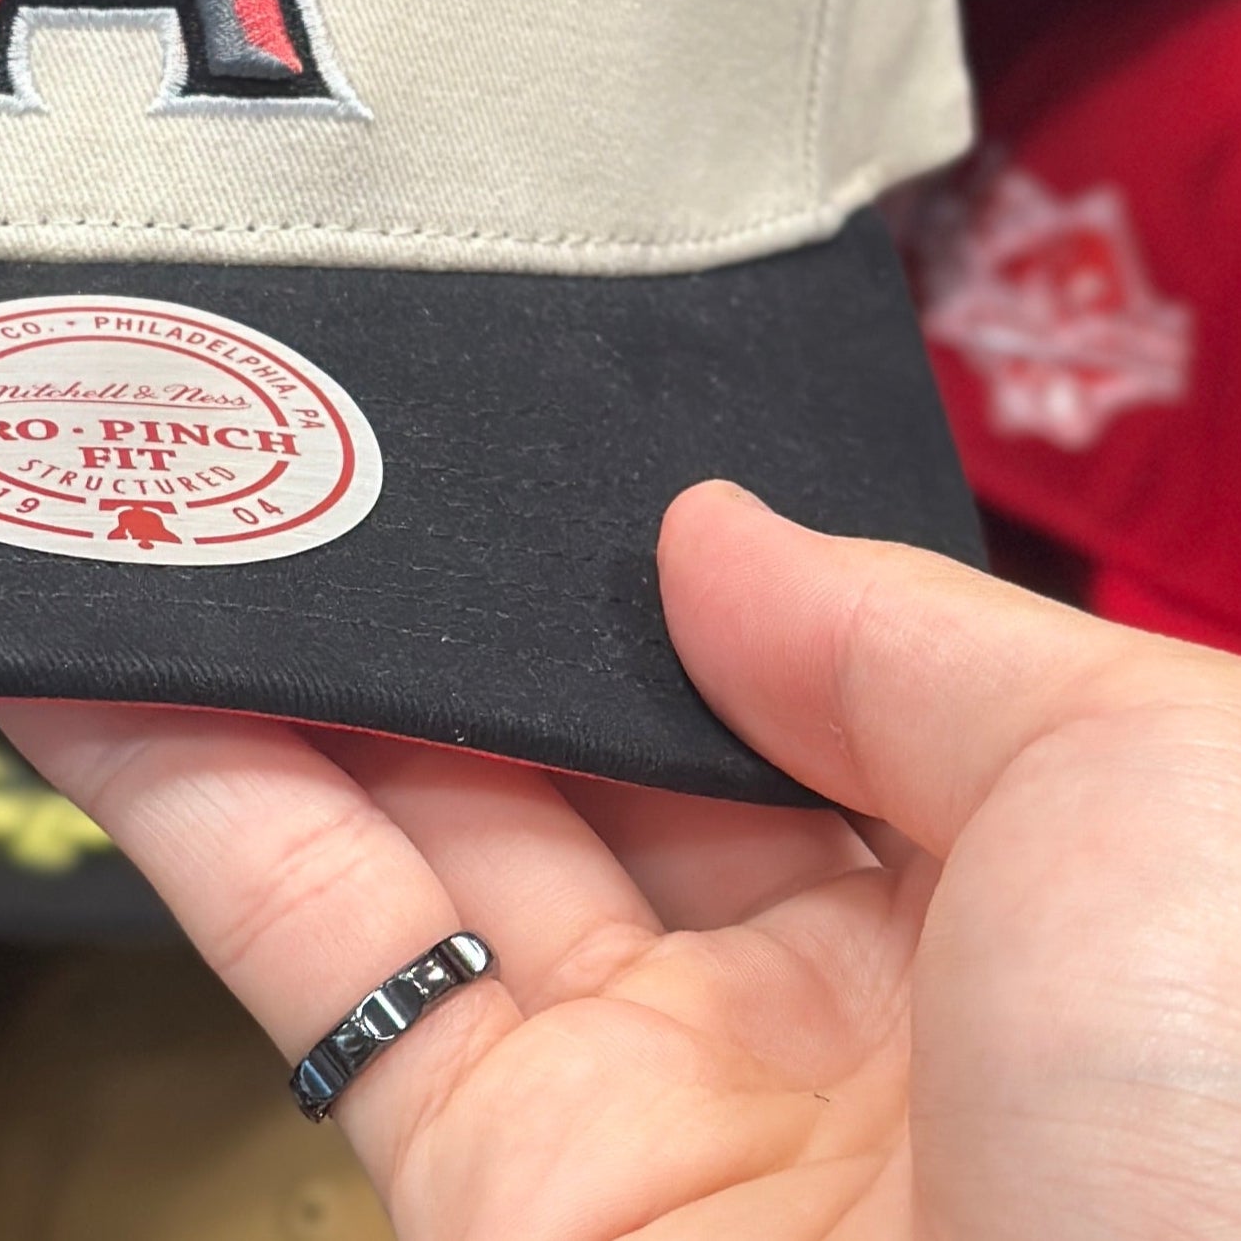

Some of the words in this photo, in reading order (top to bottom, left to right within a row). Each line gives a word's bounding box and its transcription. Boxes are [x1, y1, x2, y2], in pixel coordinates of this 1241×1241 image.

[1, 321, 54, 340] CO.
[94, 316, 297, 400] PHILADELPHIA,
[295, 408, 326, 429] PA
[133, 384, 161, 400] &
[163, 383, 251, 407] Ness
[99, 419, 301, 456] PINCH
[79, 446, 176, 471] FIT
[18, 458, 237, 495] STRUCTURED
[233, 498, 284, 526] 04
